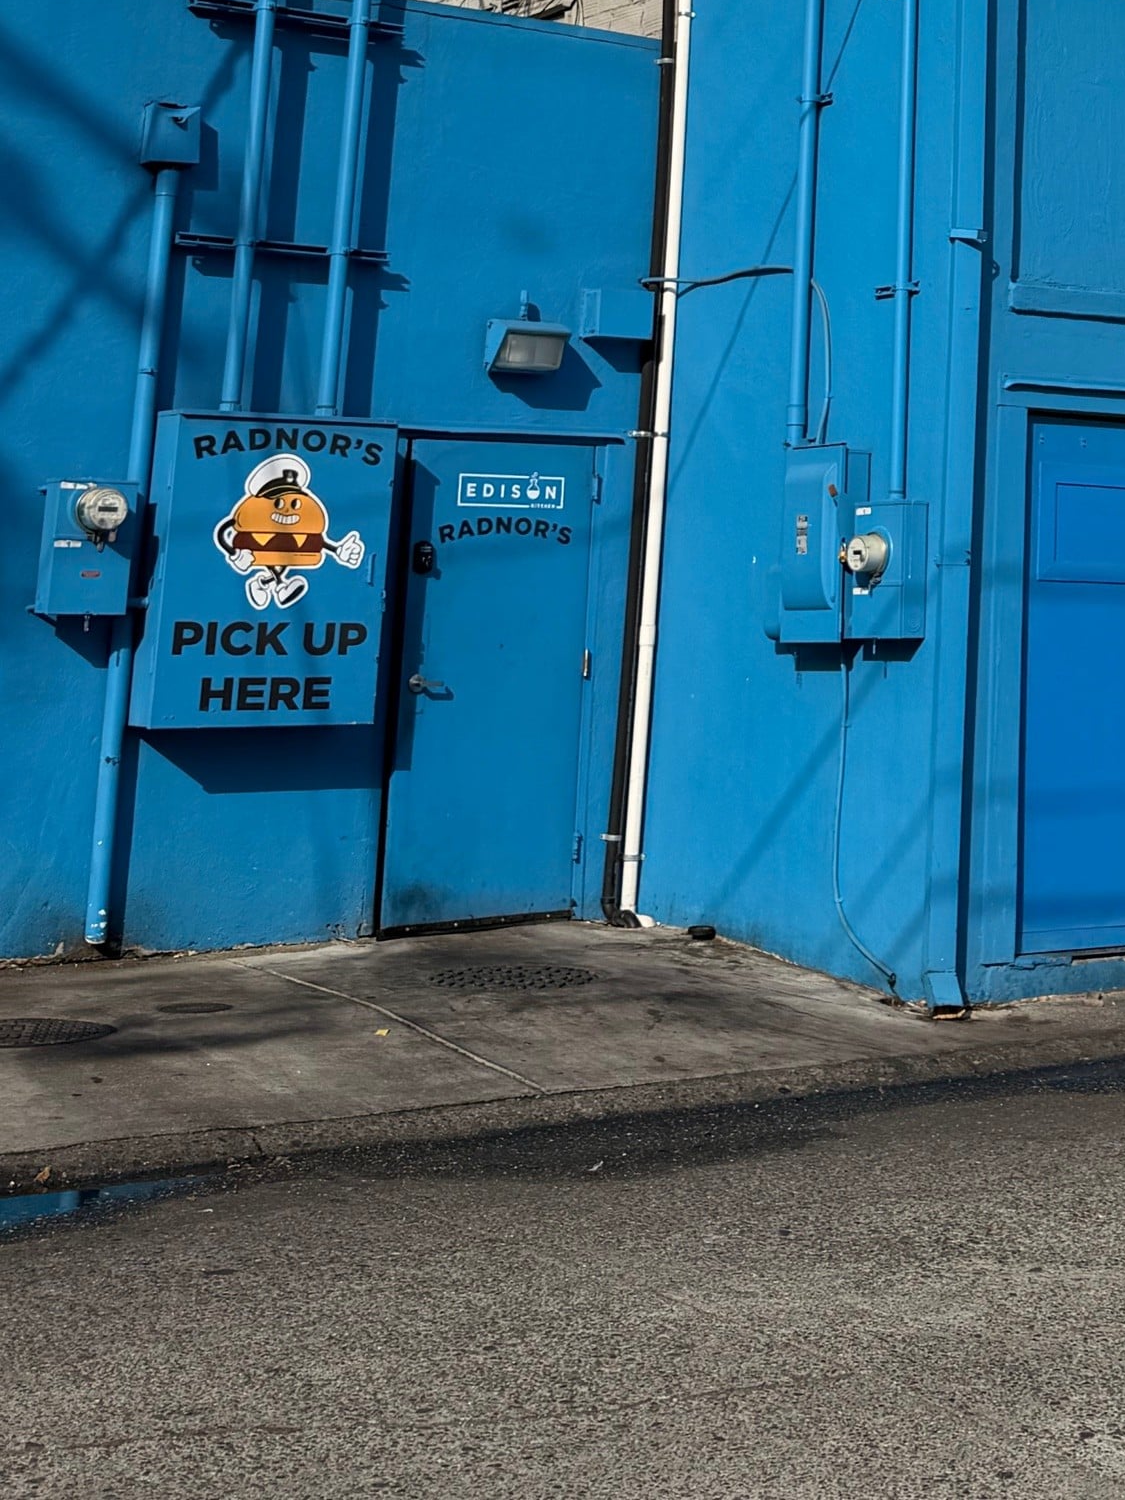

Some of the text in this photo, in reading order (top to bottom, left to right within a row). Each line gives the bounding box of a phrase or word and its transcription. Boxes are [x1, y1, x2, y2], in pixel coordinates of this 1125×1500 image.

[193, 427, 384, 466] RADNOR'S
[466, 481, 557, 500] EDISON
[438, 516, 573, 545] RADNOR'S
[171, 621, 368, 656] PICK UP
[199, 676, 333, 712] HERE
